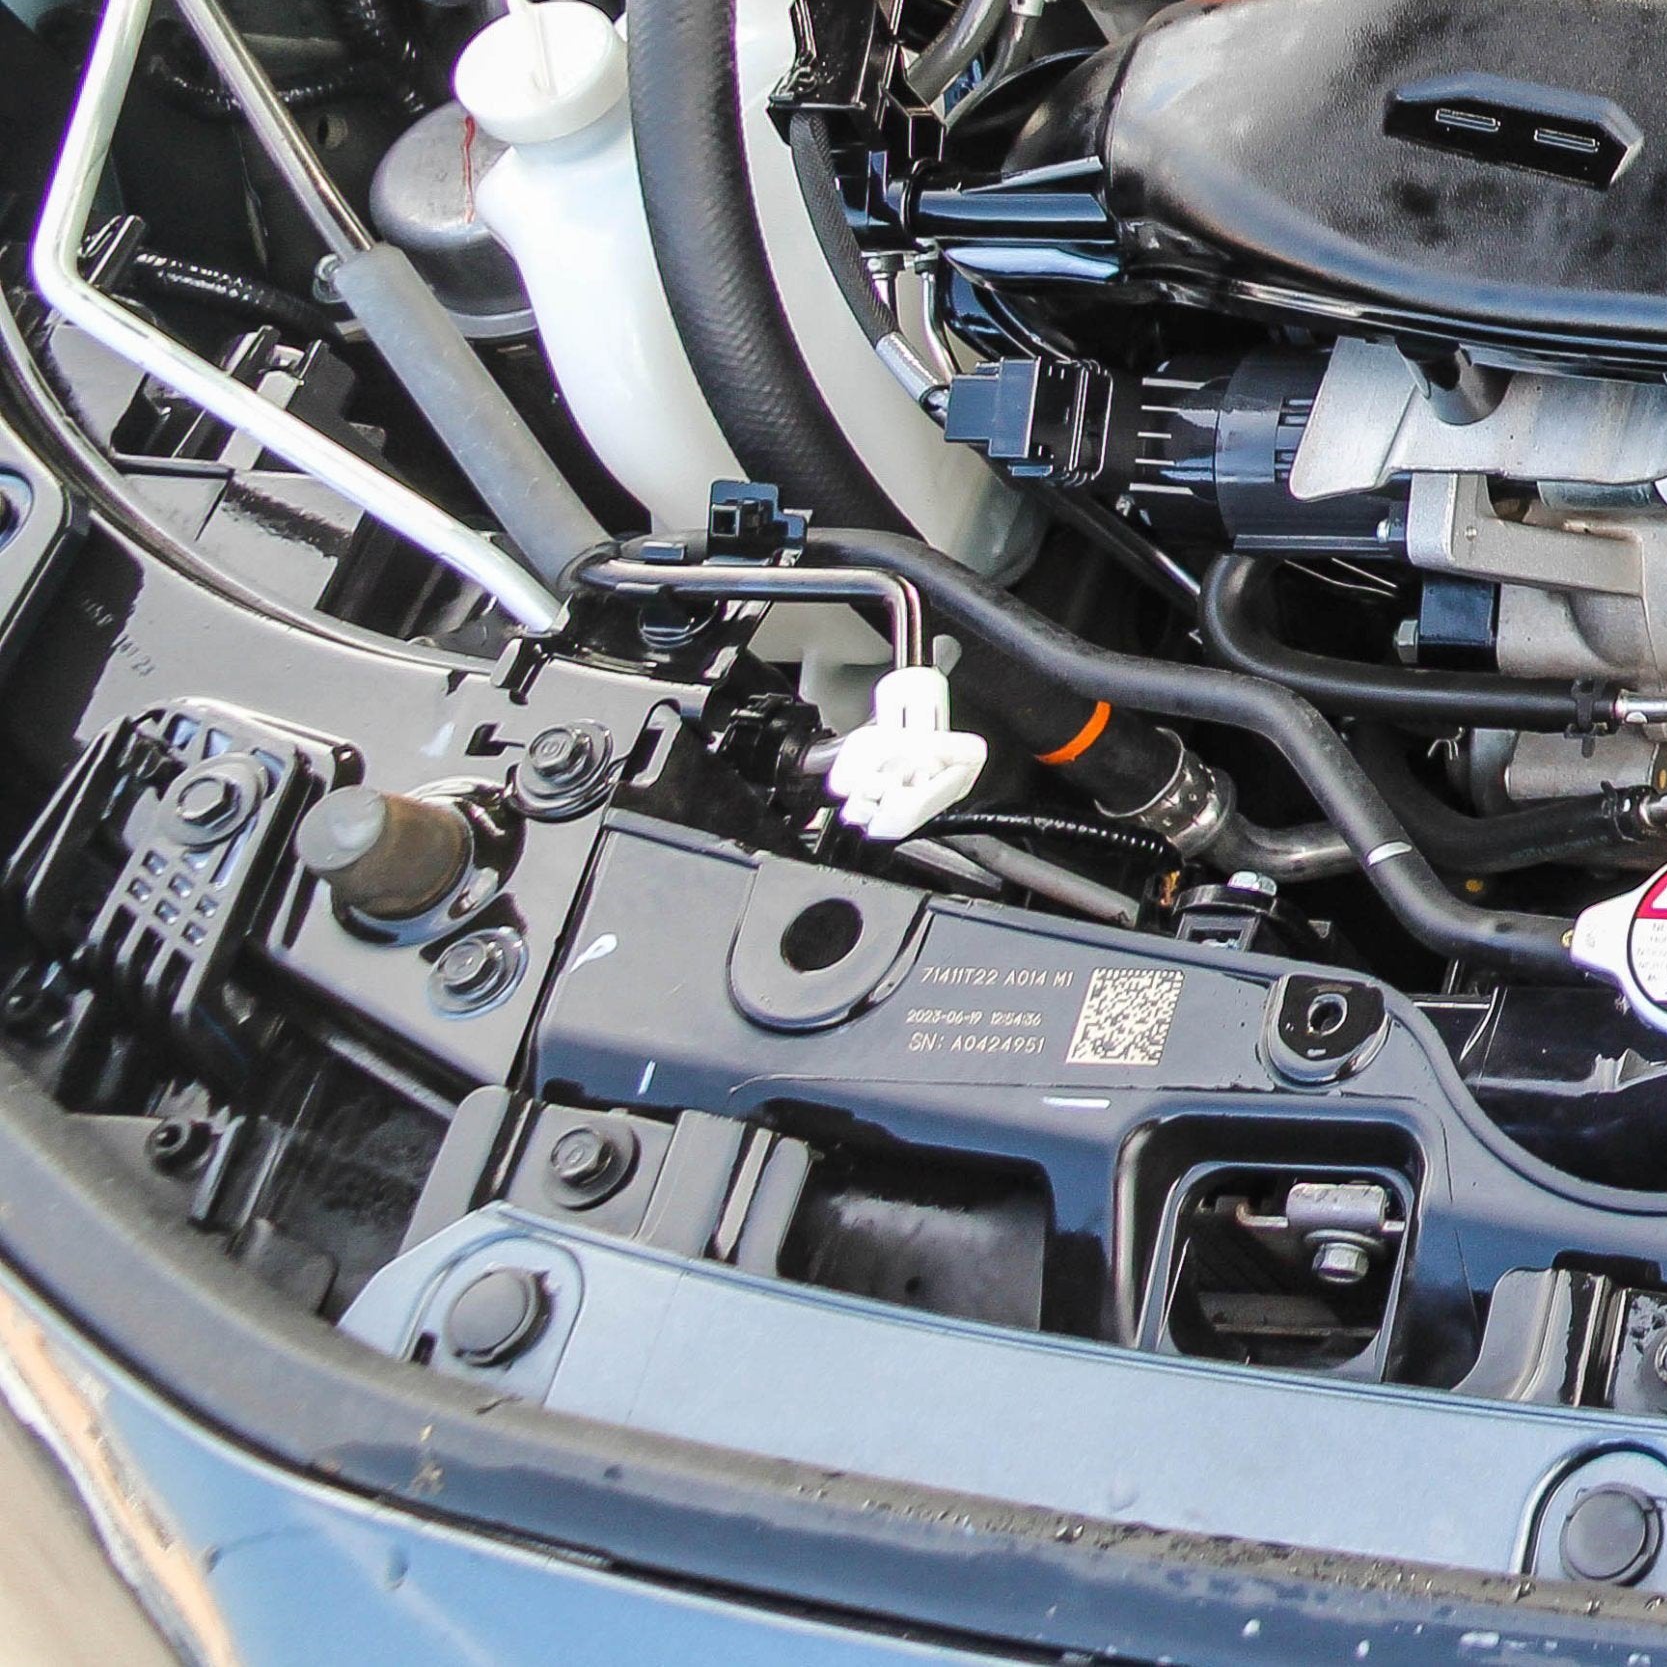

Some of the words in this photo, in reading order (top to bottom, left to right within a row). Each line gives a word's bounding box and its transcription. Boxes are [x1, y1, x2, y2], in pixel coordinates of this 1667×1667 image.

[920, 966, 999, 984] 71411T22
[1003, 969, 1047, 986] A014
[1053, 971, 1074, 987] M1
[905, 1009, 984, 1026] 2023-06-19
[908, 1031, 943, 1052] SN:
[950, 1035, 1046, 1054] A0424951
